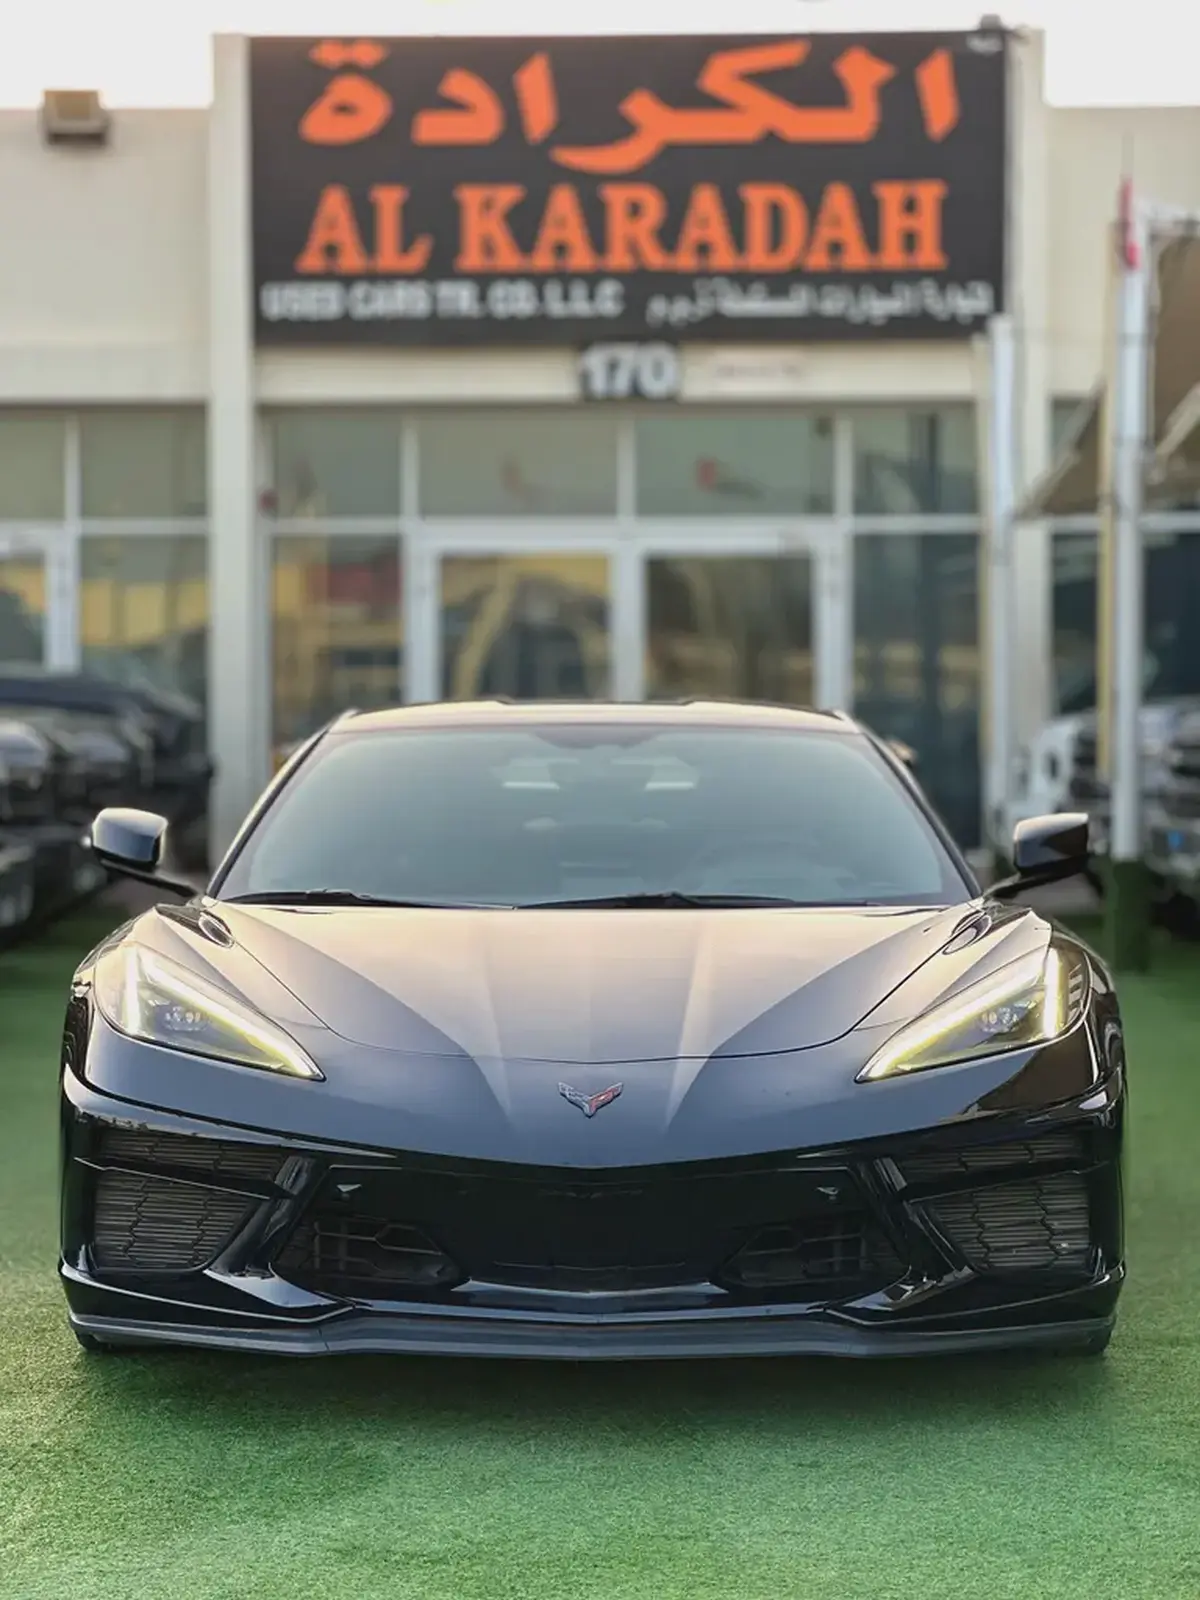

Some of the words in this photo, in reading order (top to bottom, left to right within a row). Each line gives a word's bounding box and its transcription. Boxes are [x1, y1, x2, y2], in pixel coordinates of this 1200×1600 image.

[299, 39, 959, 173] الكرادة
[296, 184, 432, 272] AL
[455, 180, 948, 272] KARADAH
[581, 342, 678, 398] 170
